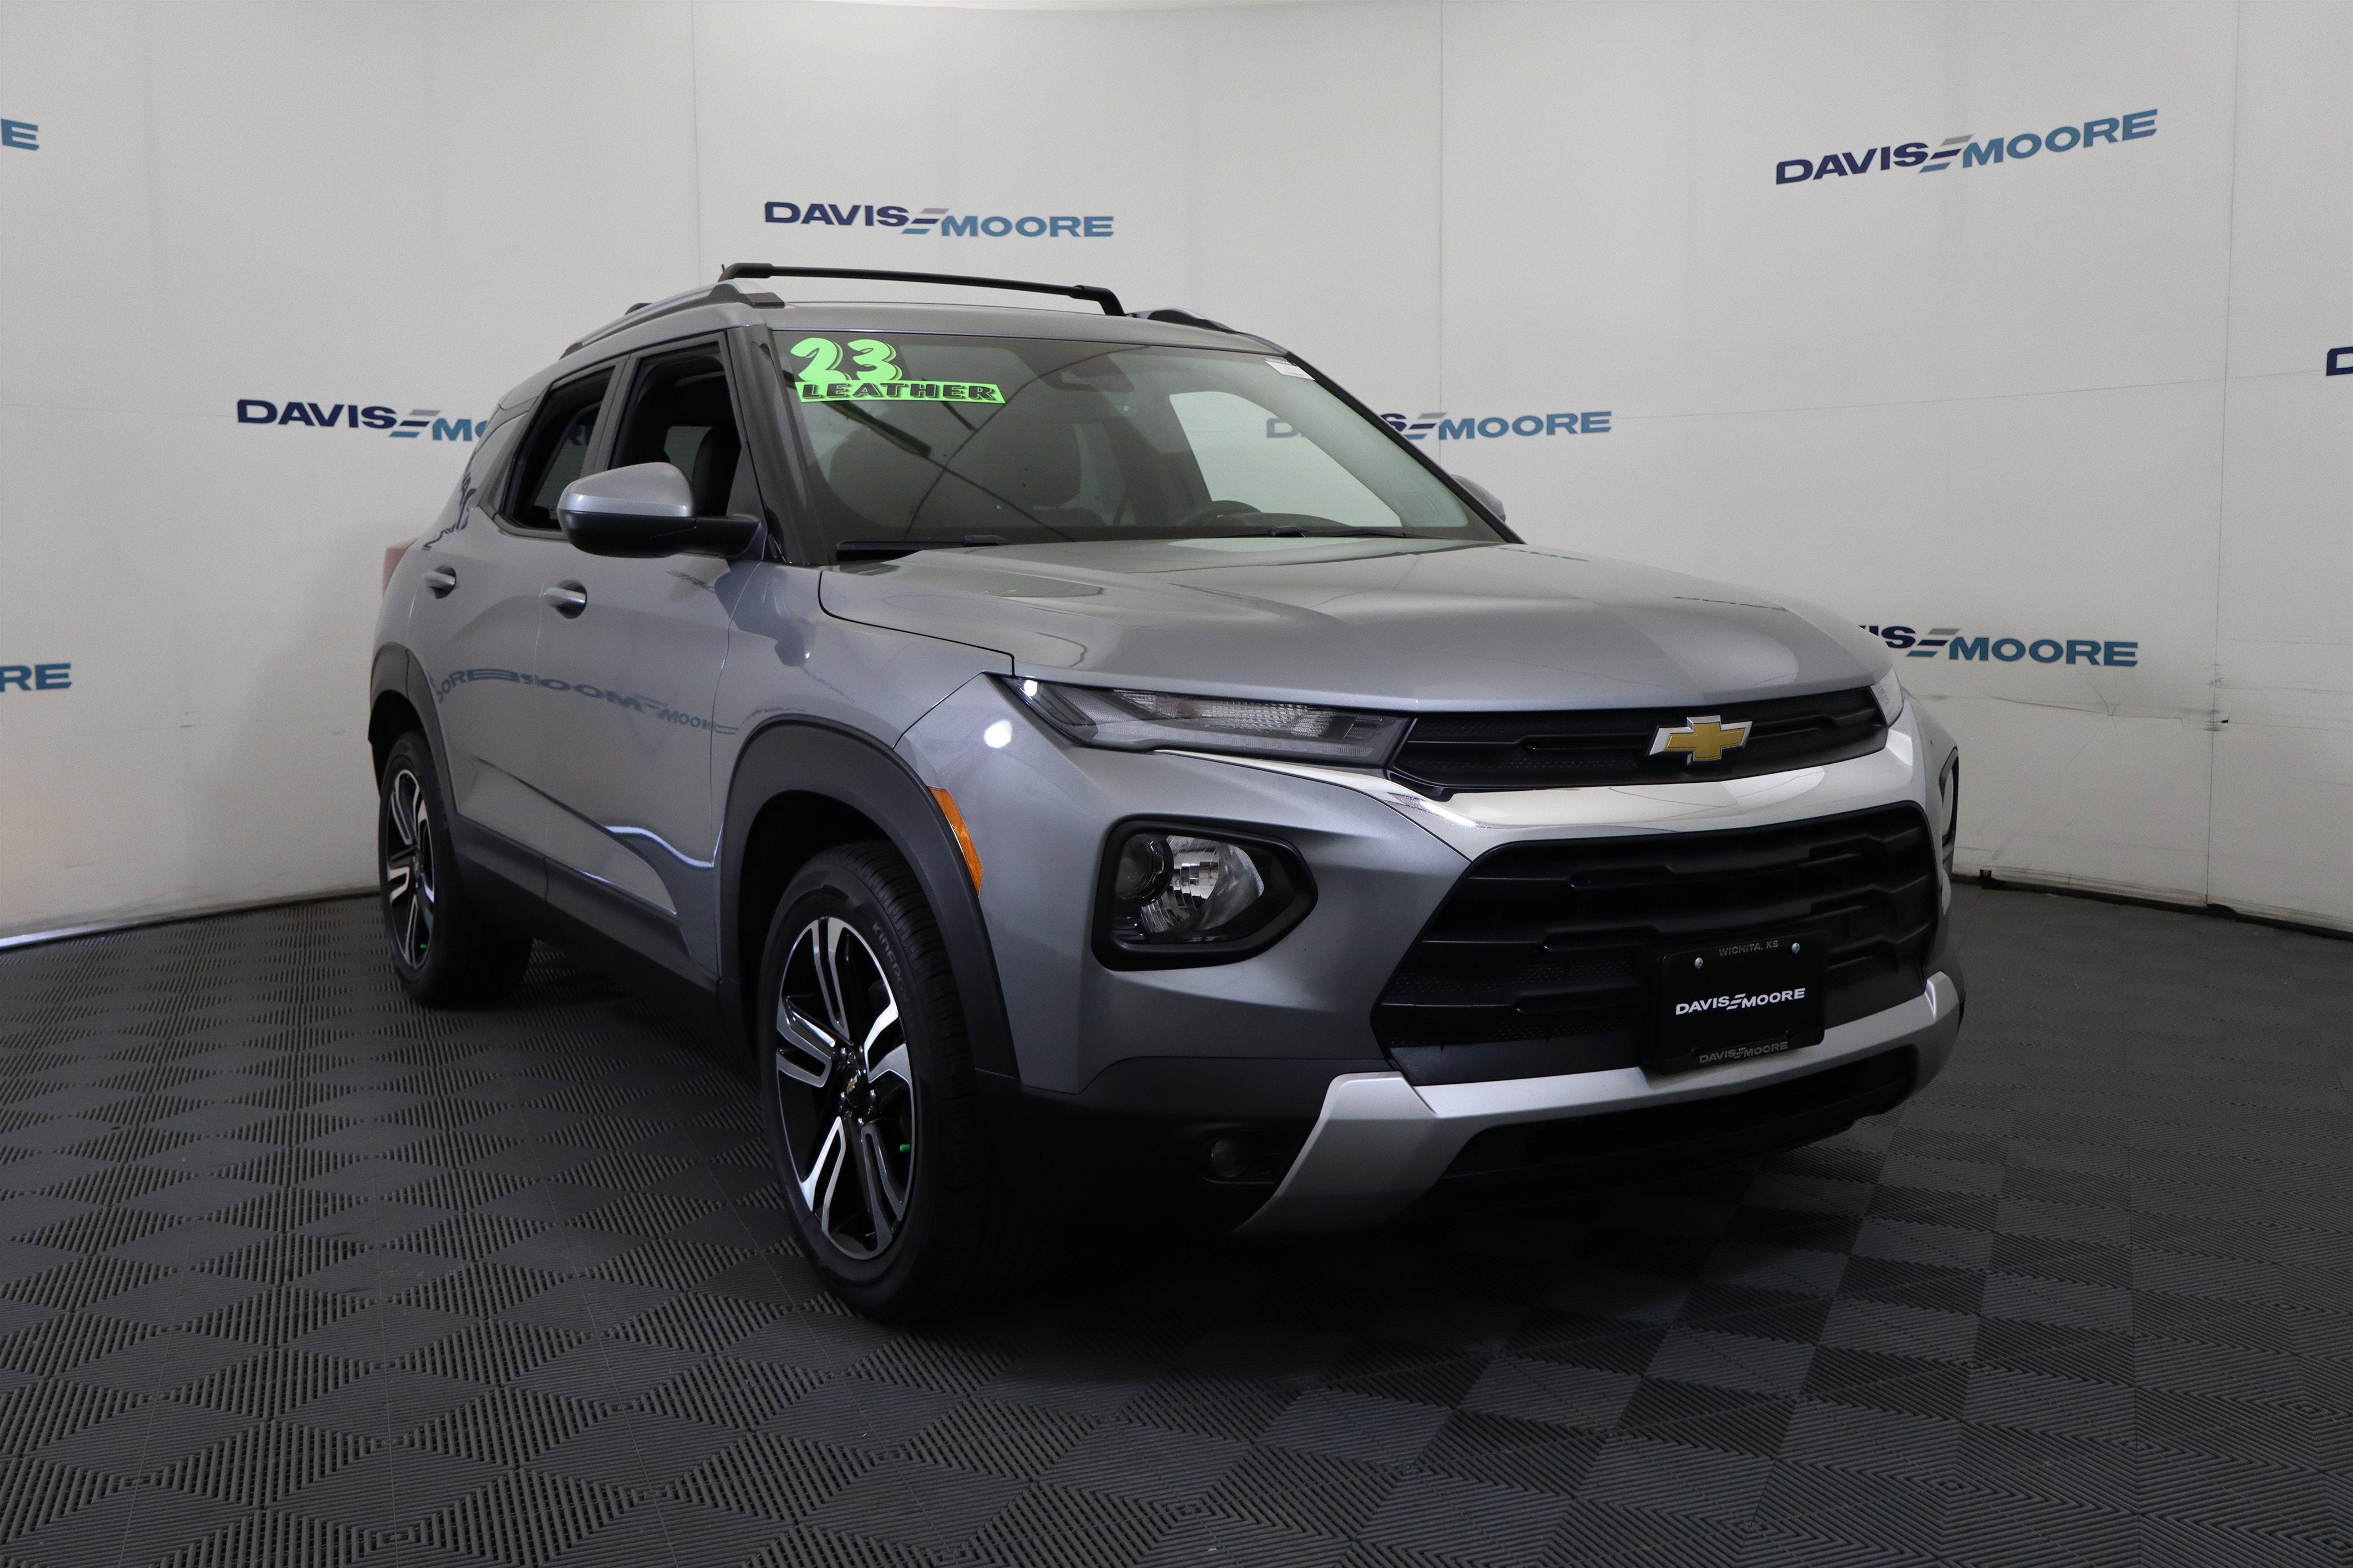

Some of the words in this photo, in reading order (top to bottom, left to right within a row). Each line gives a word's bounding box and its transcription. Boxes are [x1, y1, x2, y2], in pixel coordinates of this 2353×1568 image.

[1776, 142, 1929, 185] DAVIS
[1962, 109, 2158, 168] MOORE
[764, 201, 910, 227] DAVIS
[941, 215, 1114, 237] MOORE
[790, 337, 902, 381] 23
[802, 383, 997, 401] LEATHER
[237, 399, 398, 430] DAVIS
[1438, 411, 1611, 441] MOORE
[1949, 636, 2138, 667] MOORE
[1766, 940, 1779, 949] KS
[1675, 995, 1730, 1015] DAVIS
[1741, 987, 1806, 1009] MOORE
[1699, 1049, 1736, 1064] DAVIS
[1745, 1041, 1789, 1059] MOORE
